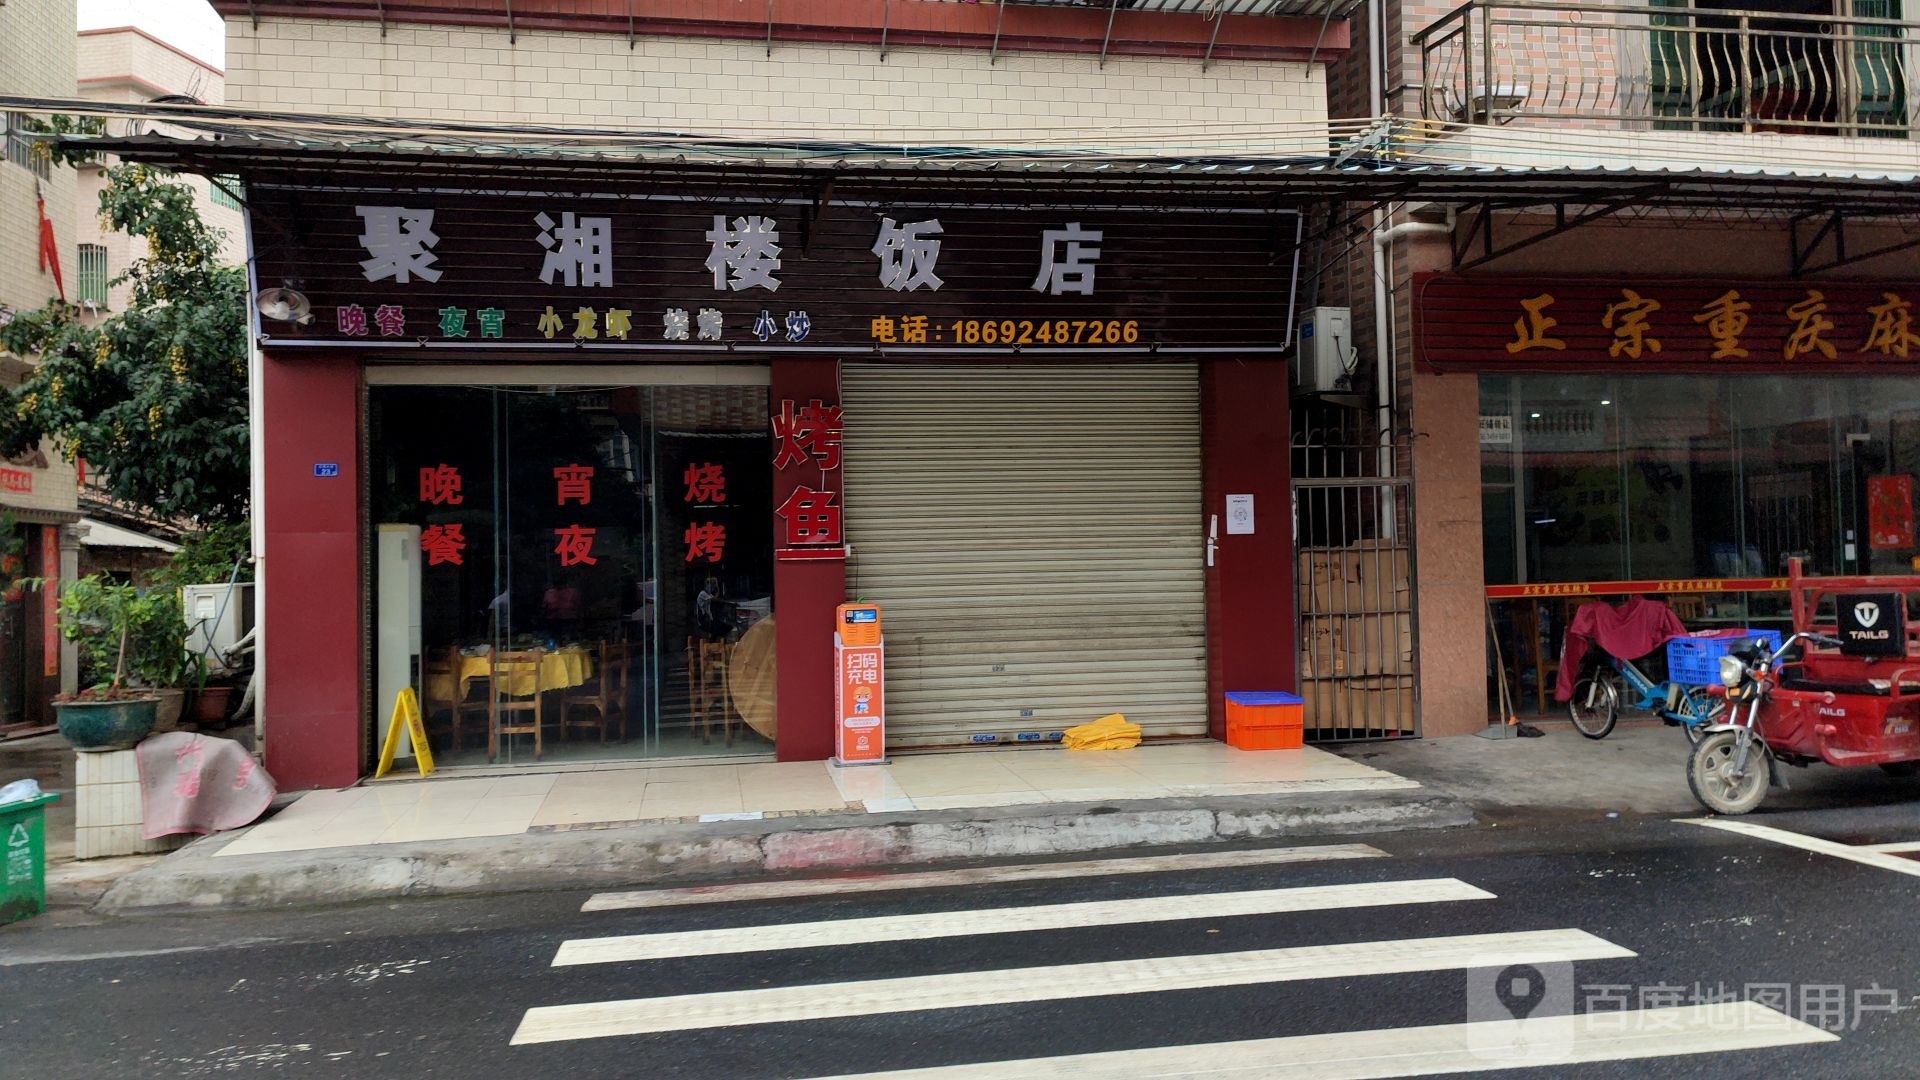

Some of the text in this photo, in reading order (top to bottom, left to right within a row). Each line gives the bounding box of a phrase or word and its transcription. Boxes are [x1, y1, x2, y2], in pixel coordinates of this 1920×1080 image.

[355, 205, 1103, 296] 聚湘楼饭店
[336, 303, 408, 338] 晚餐
[437, 306, 505, 340] 夜宵
[537, 305, 634, 341] 小龙虾
[752, 309, 812, 344] 小炒
[1505, 288, 1920, 361] 正宗重庆麻
[771, 398, 844, 546] 烤鱼
[418, 463, 466, 567] 晚餐
[683, 462, 727, 564] 烧烤
[847, 652, 878, 669] 扫码
[1849, 630, 1890, 640] TAILG
[847, 669, 878, 685] 充电
